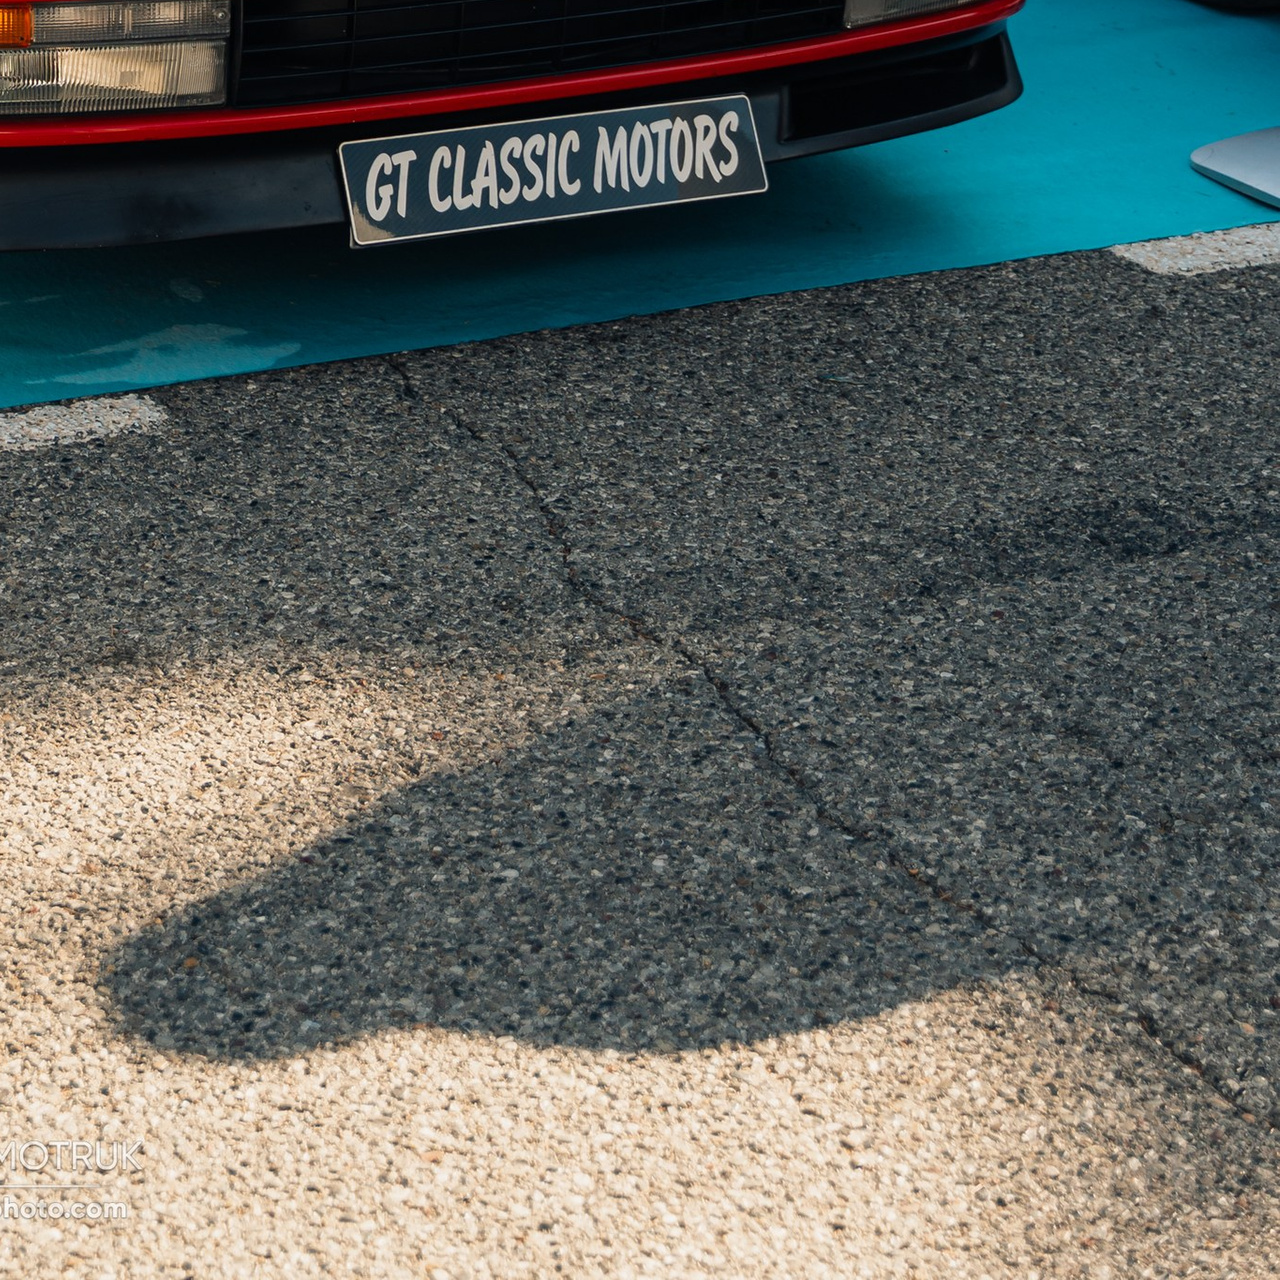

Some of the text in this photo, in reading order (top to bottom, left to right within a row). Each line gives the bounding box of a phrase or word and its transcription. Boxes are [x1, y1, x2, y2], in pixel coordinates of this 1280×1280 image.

[365, 110, 739, 221] GT CLASSIC MOTORS
